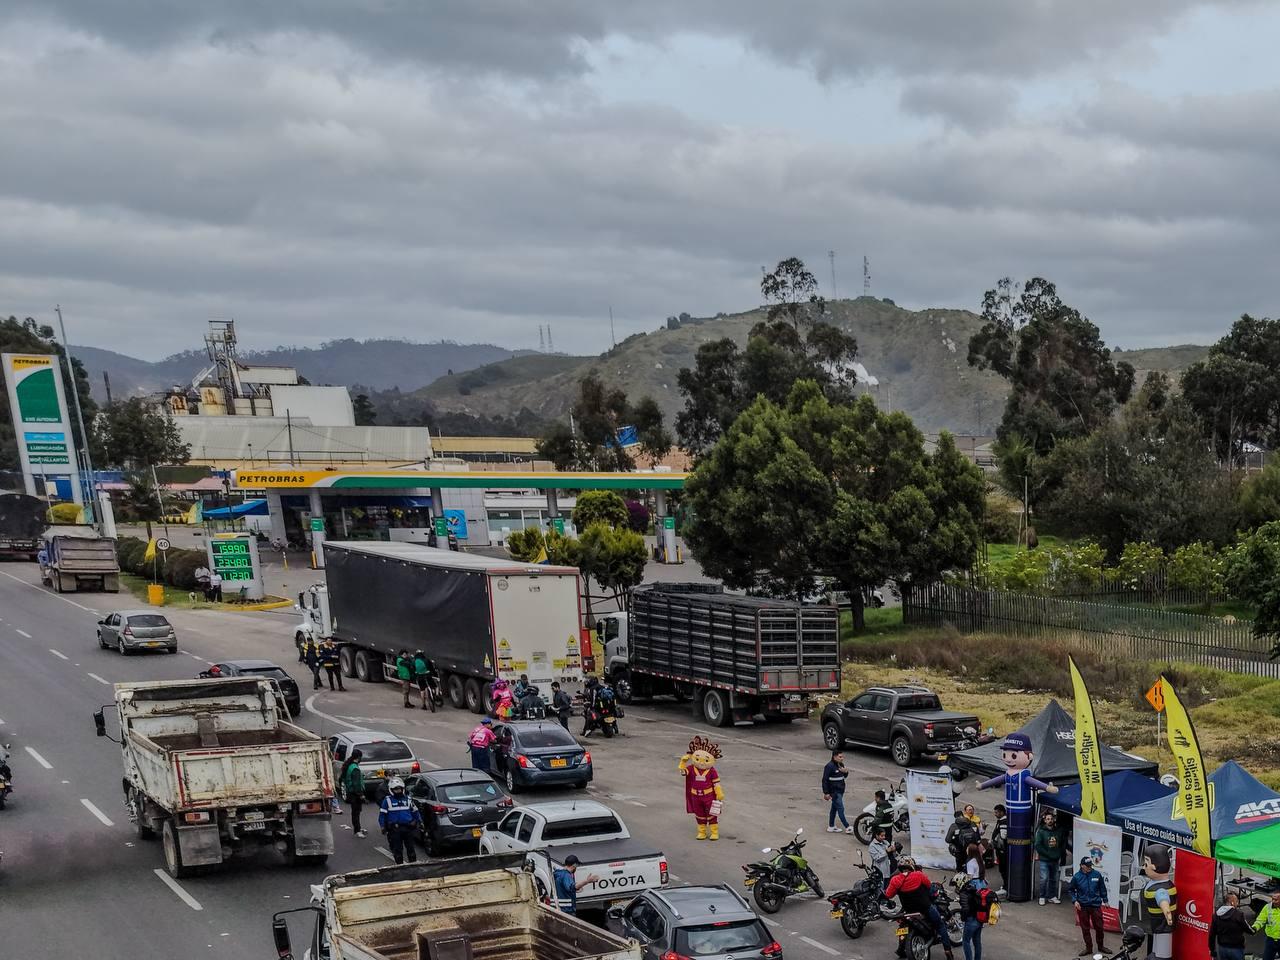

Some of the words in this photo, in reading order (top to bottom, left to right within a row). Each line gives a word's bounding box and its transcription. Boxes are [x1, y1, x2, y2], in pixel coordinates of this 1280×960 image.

[239, 475, 305, 483] PETROBRAS
[1124, 818, 1136, 831] Usa
[1136, 822, 1143, 832] el
[1142, 825, 1160, 838] casco
[1160, 829, 1175, 842] cuida
[592, 875, 646, 890] TOYOTA
